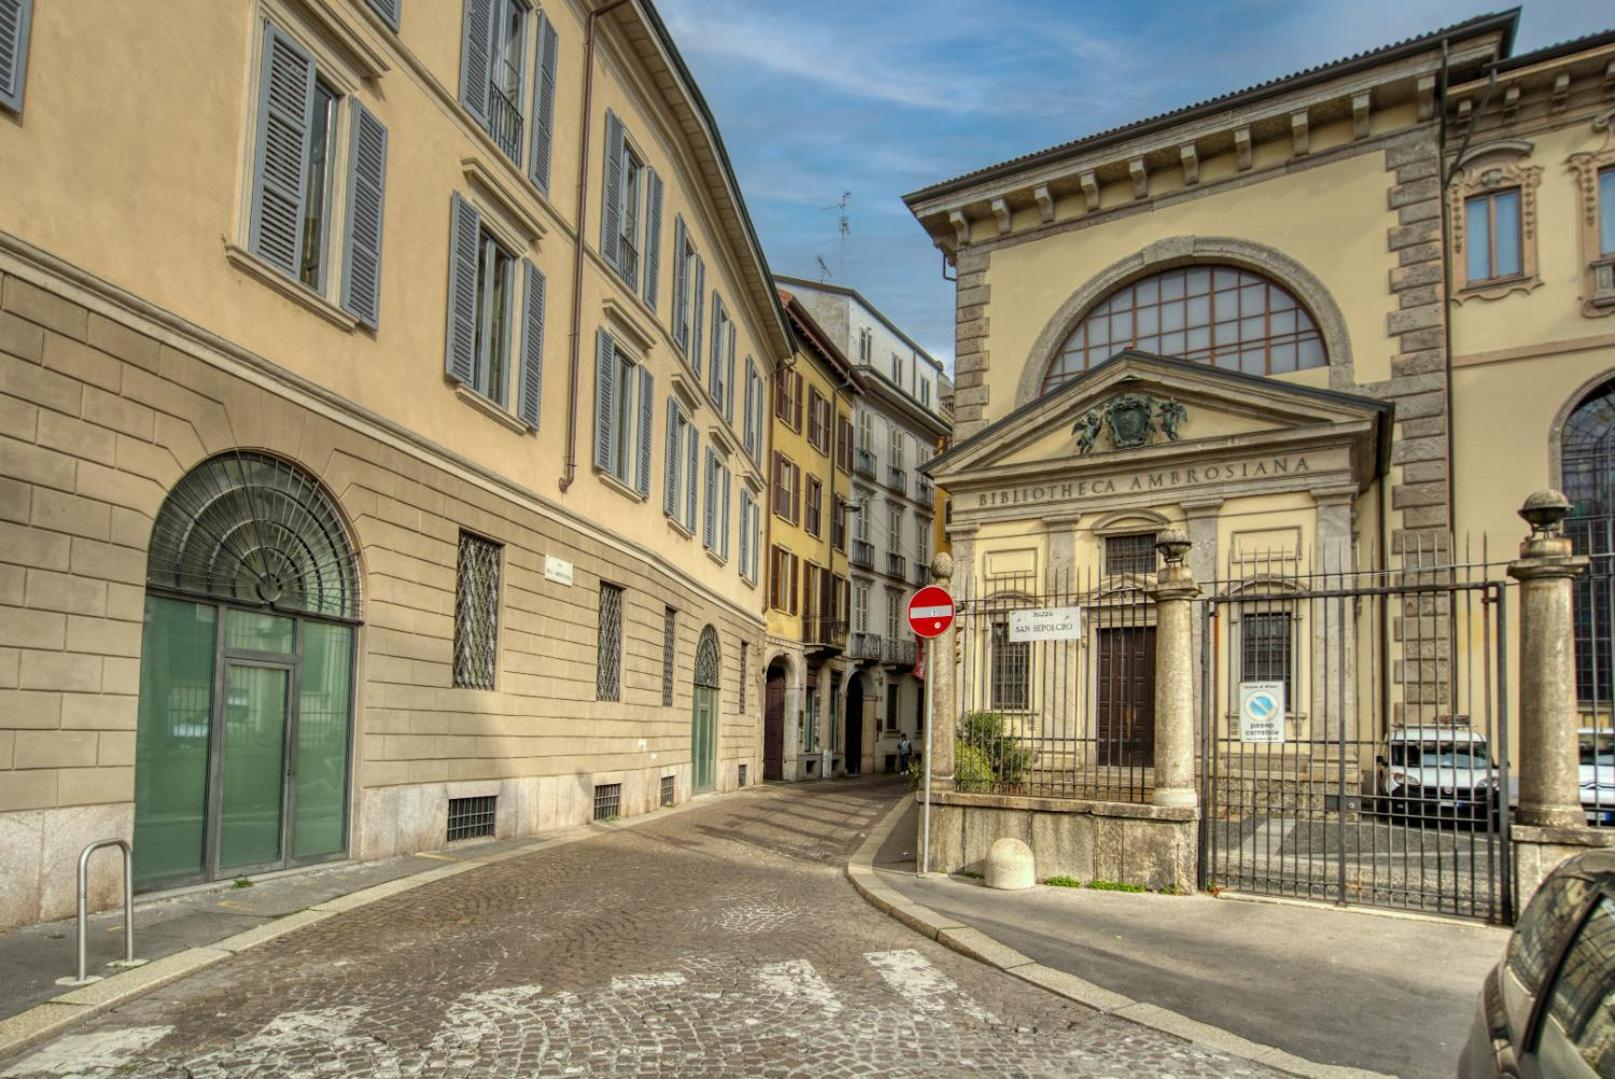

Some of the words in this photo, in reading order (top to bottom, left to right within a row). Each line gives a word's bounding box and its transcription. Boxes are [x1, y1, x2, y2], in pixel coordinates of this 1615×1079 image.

[978, 479, 1115, 506] BIBLIOTHECA
[1130, 456, 1310, 490] AMBROSIANA
[1015, 624, 1030, 634] SAN
